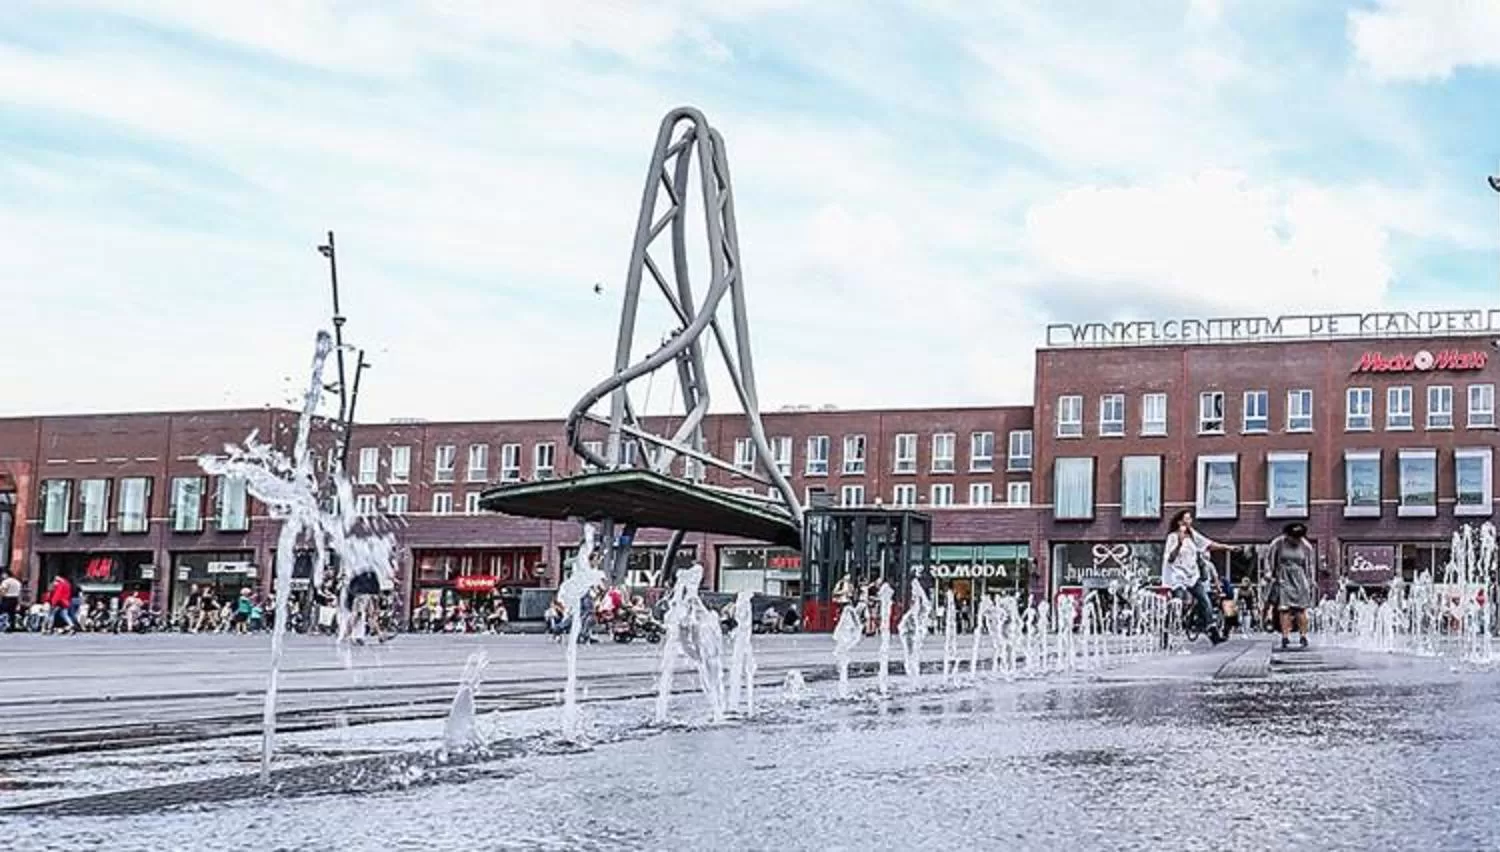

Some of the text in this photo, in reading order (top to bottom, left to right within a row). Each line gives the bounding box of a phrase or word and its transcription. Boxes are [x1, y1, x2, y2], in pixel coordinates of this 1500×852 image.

[1071, 315, 1283, 341] WINKELCENTRUM
[1311, 315, 1339, 334] DE
[952, 564, 1008, 577] MODA
